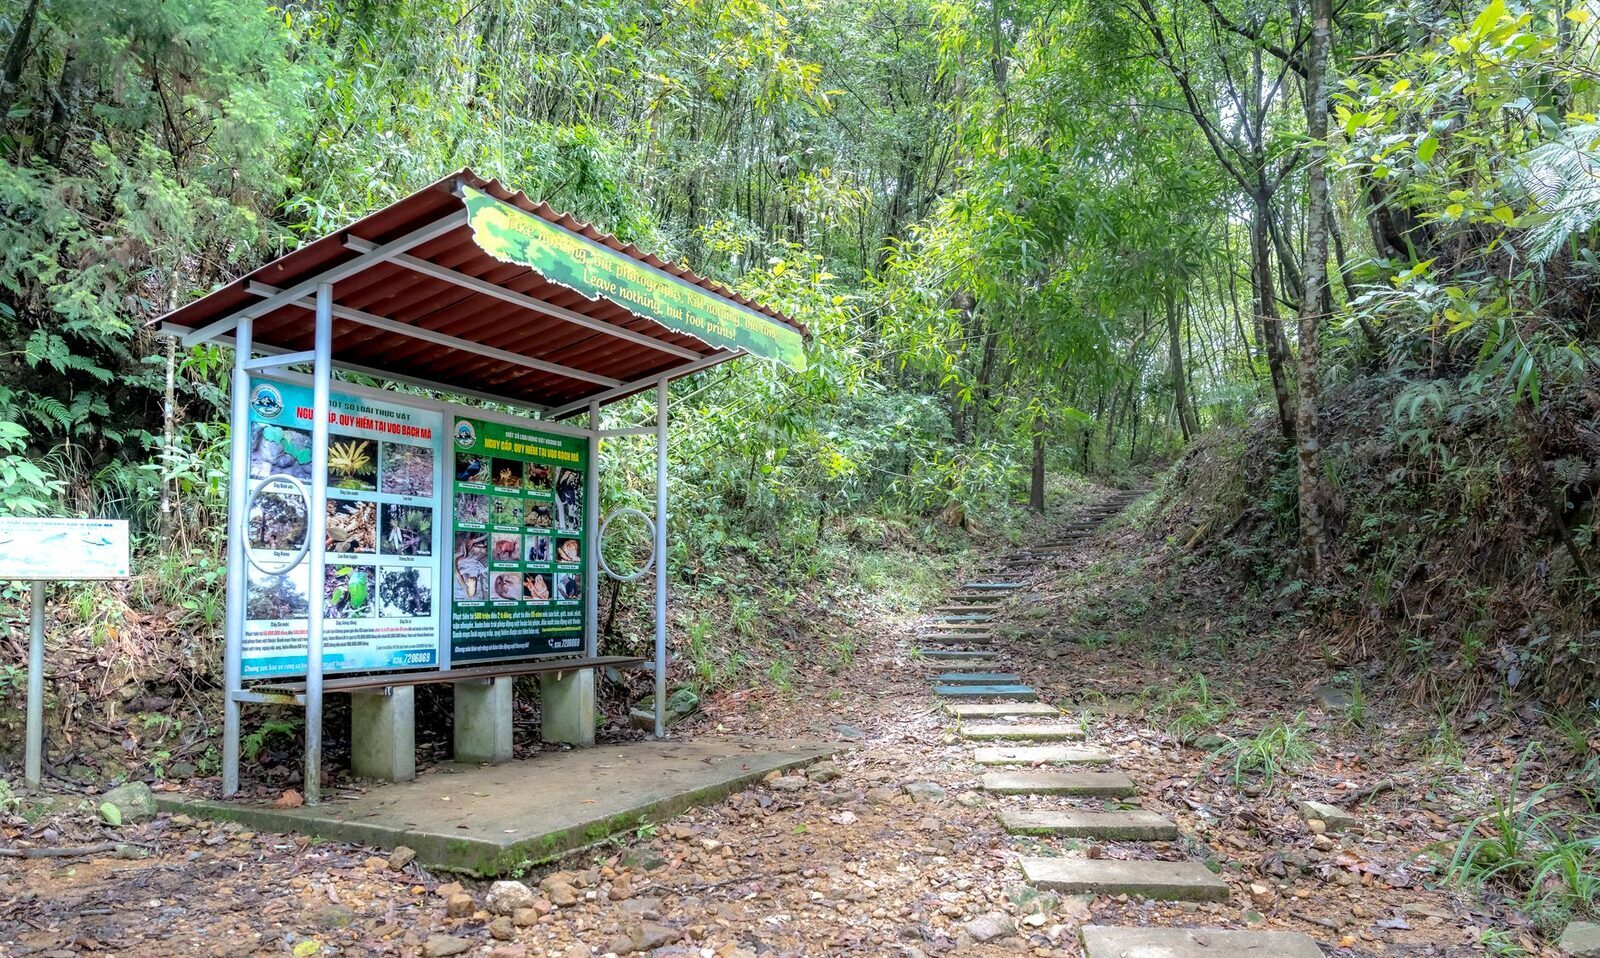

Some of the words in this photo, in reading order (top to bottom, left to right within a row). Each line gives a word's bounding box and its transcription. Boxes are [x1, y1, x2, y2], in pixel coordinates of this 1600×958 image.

[507, 210, 534, 237] Take
[594, 251, 613, 272] but
[687, 291, 705, 310] Kill
[583, 267, 617, 294] Leave
[619, 286, 663, 315] nothing,
[666, 303, 683, 320] but
[685, 310, 705, 328] foot
[706, 319, 737, 341] prints!
[296, 406, 314, 420] NGU
